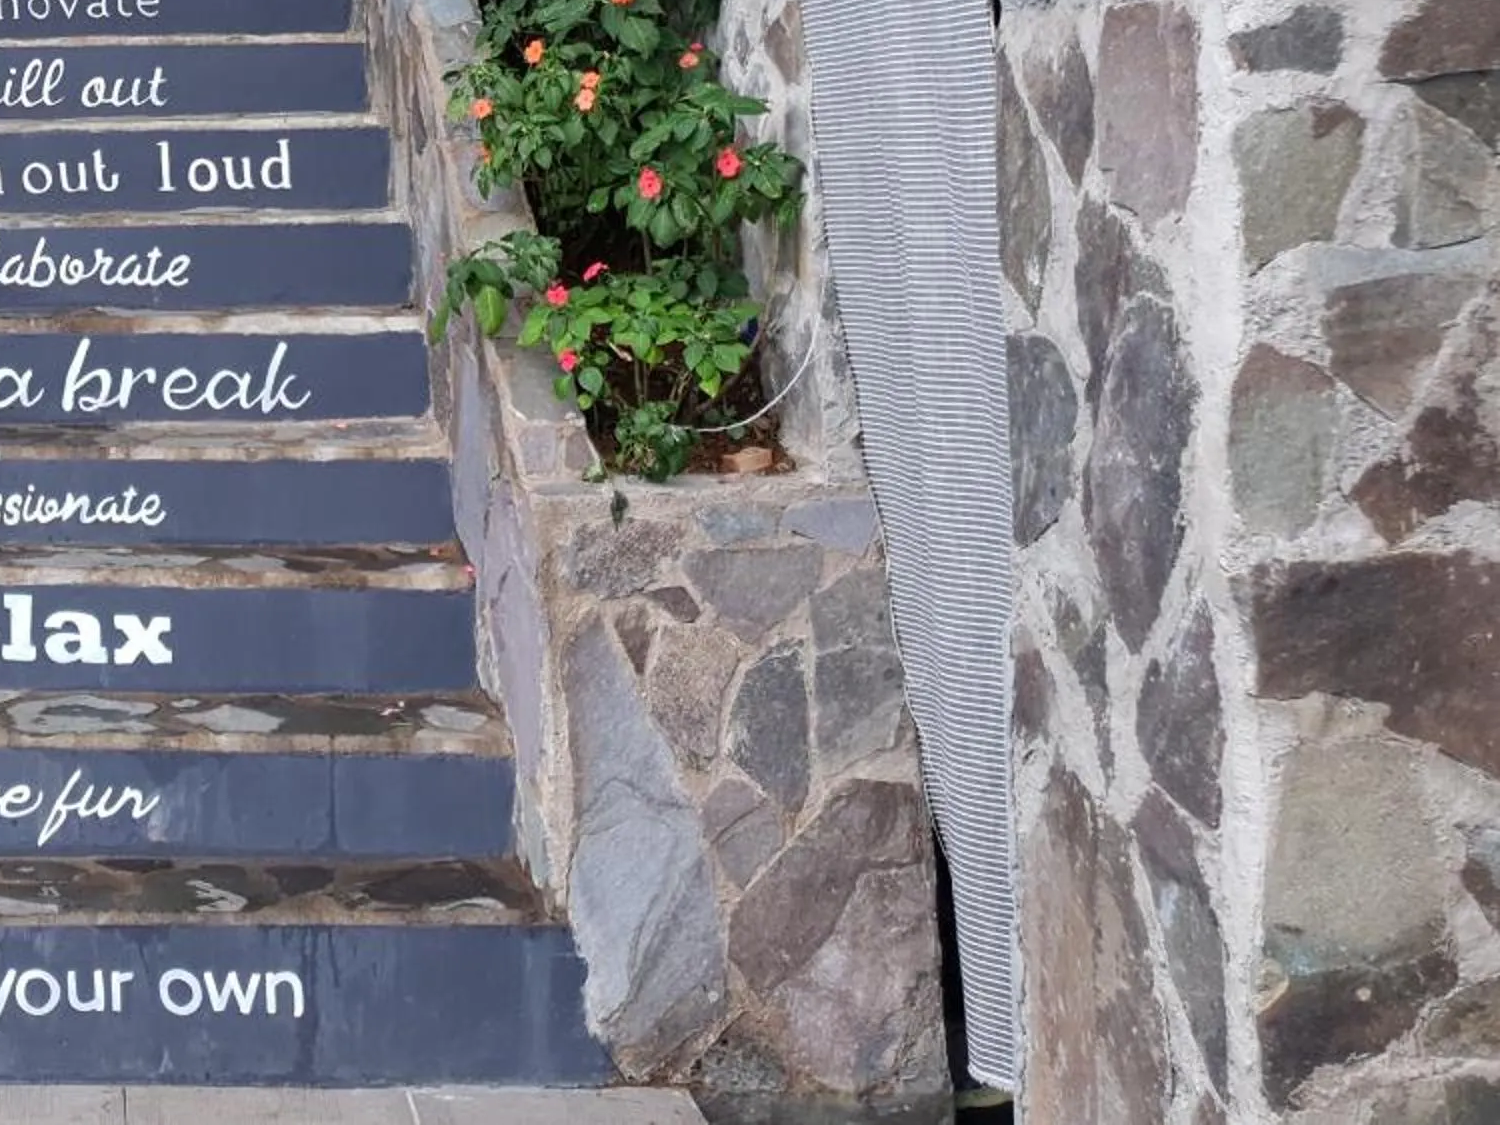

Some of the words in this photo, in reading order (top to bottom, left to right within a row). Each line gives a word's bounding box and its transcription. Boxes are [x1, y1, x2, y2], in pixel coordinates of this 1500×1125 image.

[79, 65, 167, 109] out
[21, 148, 120, 195] out
[155, 137, 293, 193] loud
[60, 336, 312, 415] break
[36, 767, 162, 848] fun
[158, 967, 306, 1019] own
